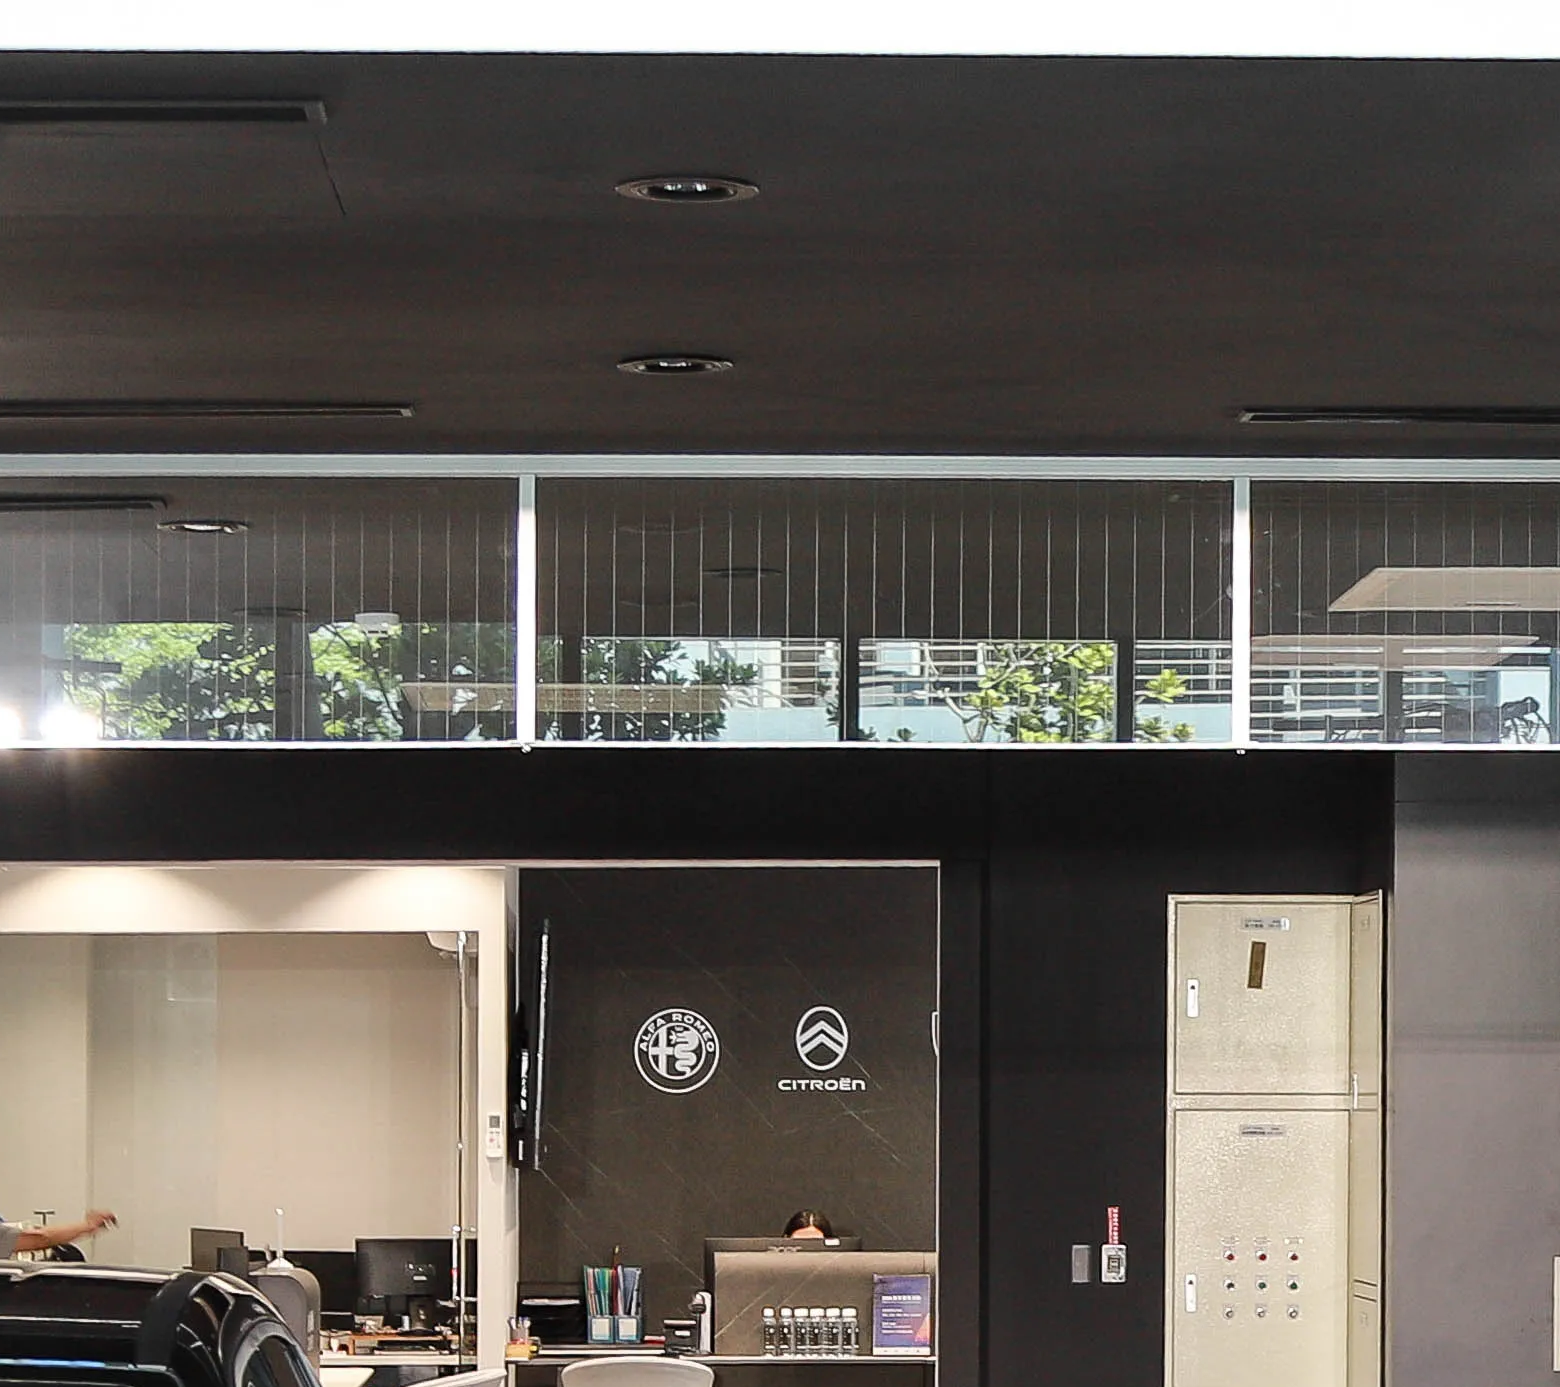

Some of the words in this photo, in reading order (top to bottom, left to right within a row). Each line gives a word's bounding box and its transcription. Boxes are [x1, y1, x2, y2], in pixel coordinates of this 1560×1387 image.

[639, 1018, 666, 1052] ALFA
[671, 1013, 715, 1053] ROMEO
[777, 1077, 867, 1092] CITROËN
